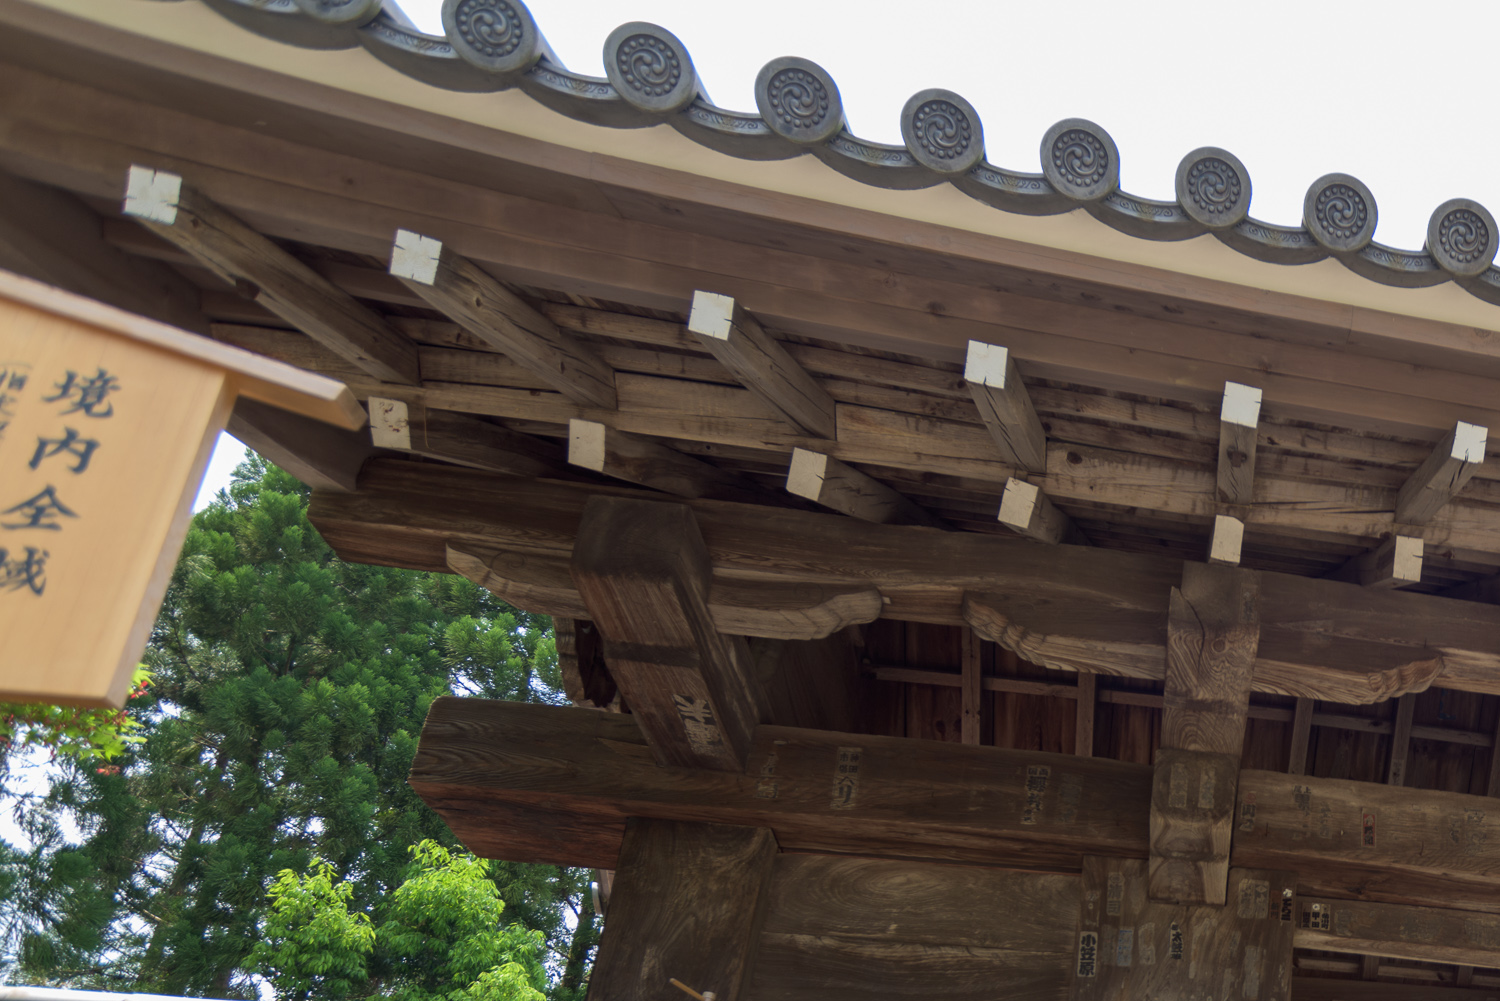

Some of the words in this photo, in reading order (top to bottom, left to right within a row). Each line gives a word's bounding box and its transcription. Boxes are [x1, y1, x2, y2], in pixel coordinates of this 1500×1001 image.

[0, 365, 122, 598] 境内全域
[1079, 934, 1097, 976] 小笠原
